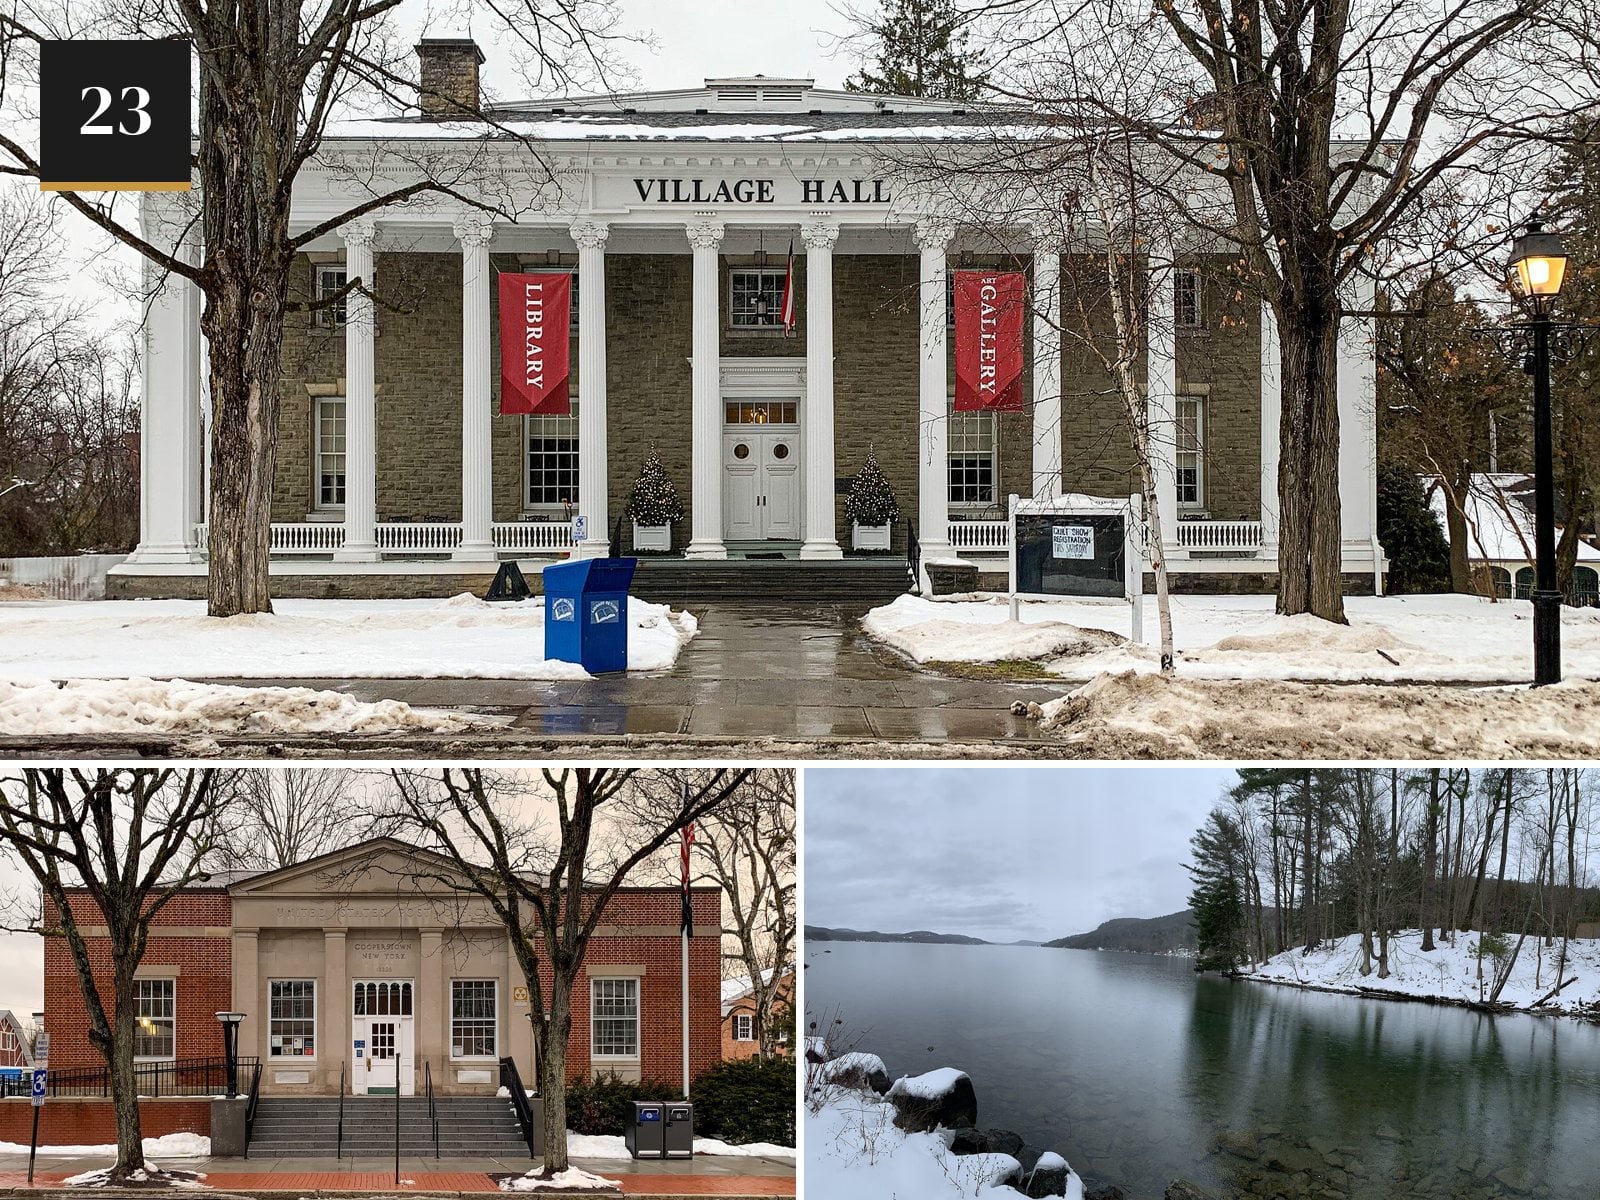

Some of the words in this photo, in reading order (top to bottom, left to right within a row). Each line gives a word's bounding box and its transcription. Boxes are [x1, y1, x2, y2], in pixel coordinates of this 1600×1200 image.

[633, 178, 775, 203] VILLAGE
[800, 179, 892, 203] HALL
[525, 283, 543, 389] LIBRARY
[980, 285, 997, 394] GALLERY
[1072, 527, 1093, 538] SHOW
[1053, 536, 1091, 544] REGISTRATION
[354, 943, 412, 951] COOPERSTOWN
[362, 952, 380, 960] NEW
